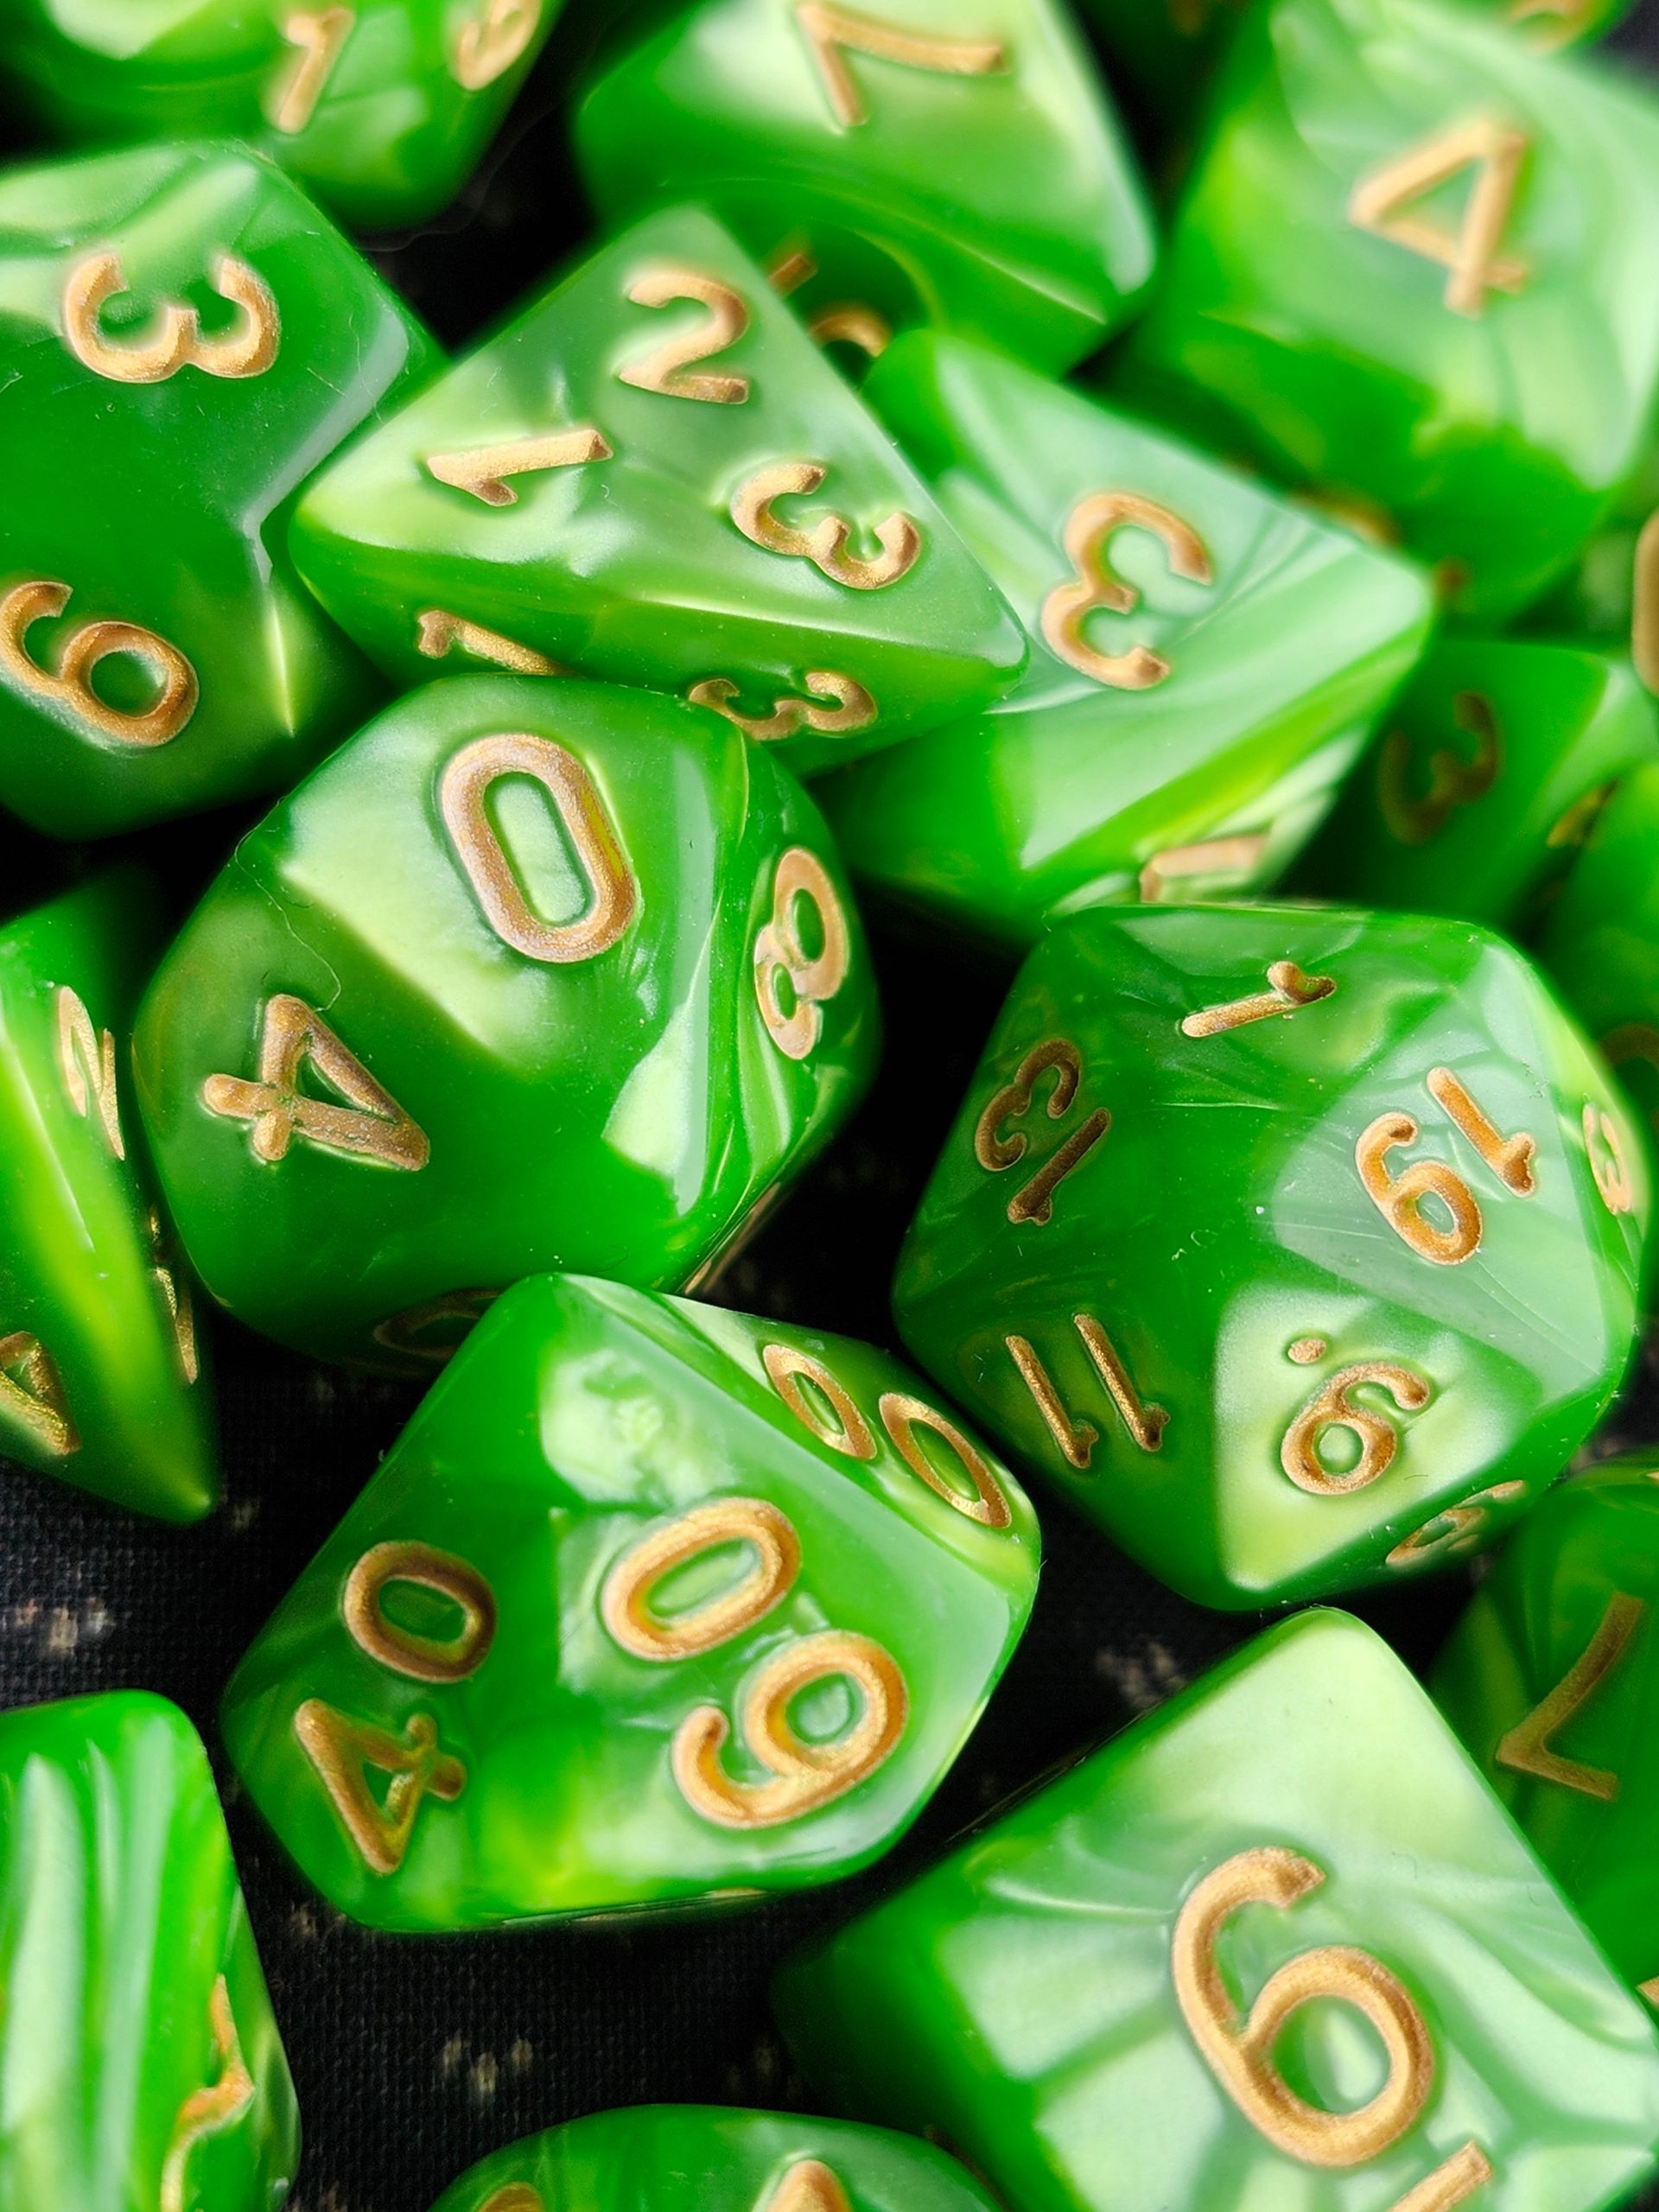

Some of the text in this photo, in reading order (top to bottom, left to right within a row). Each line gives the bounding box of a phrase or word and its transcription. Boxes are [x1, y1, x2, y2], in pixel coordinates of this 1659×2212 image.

[1348, 112, 1528, 320] 4
[62, 249, 281, 385] 3
[618, 272, 750, 404] 2
[427, 429, 613, 506] 1
[731, 463, 921, 590] 3
[1041, 493, 1211, 690] 3
[439, 733, 638, 963] 0
[754, 846, 850, 1060] 8
[203, 994, 430, 1172] 4
[975, 1039, 1112, 1226] 13
[762, 1343, 1013, 1529] 00
[1497, 1590, 1645, 1803] 7
[1171, 1846, 1434, 2167] 6
